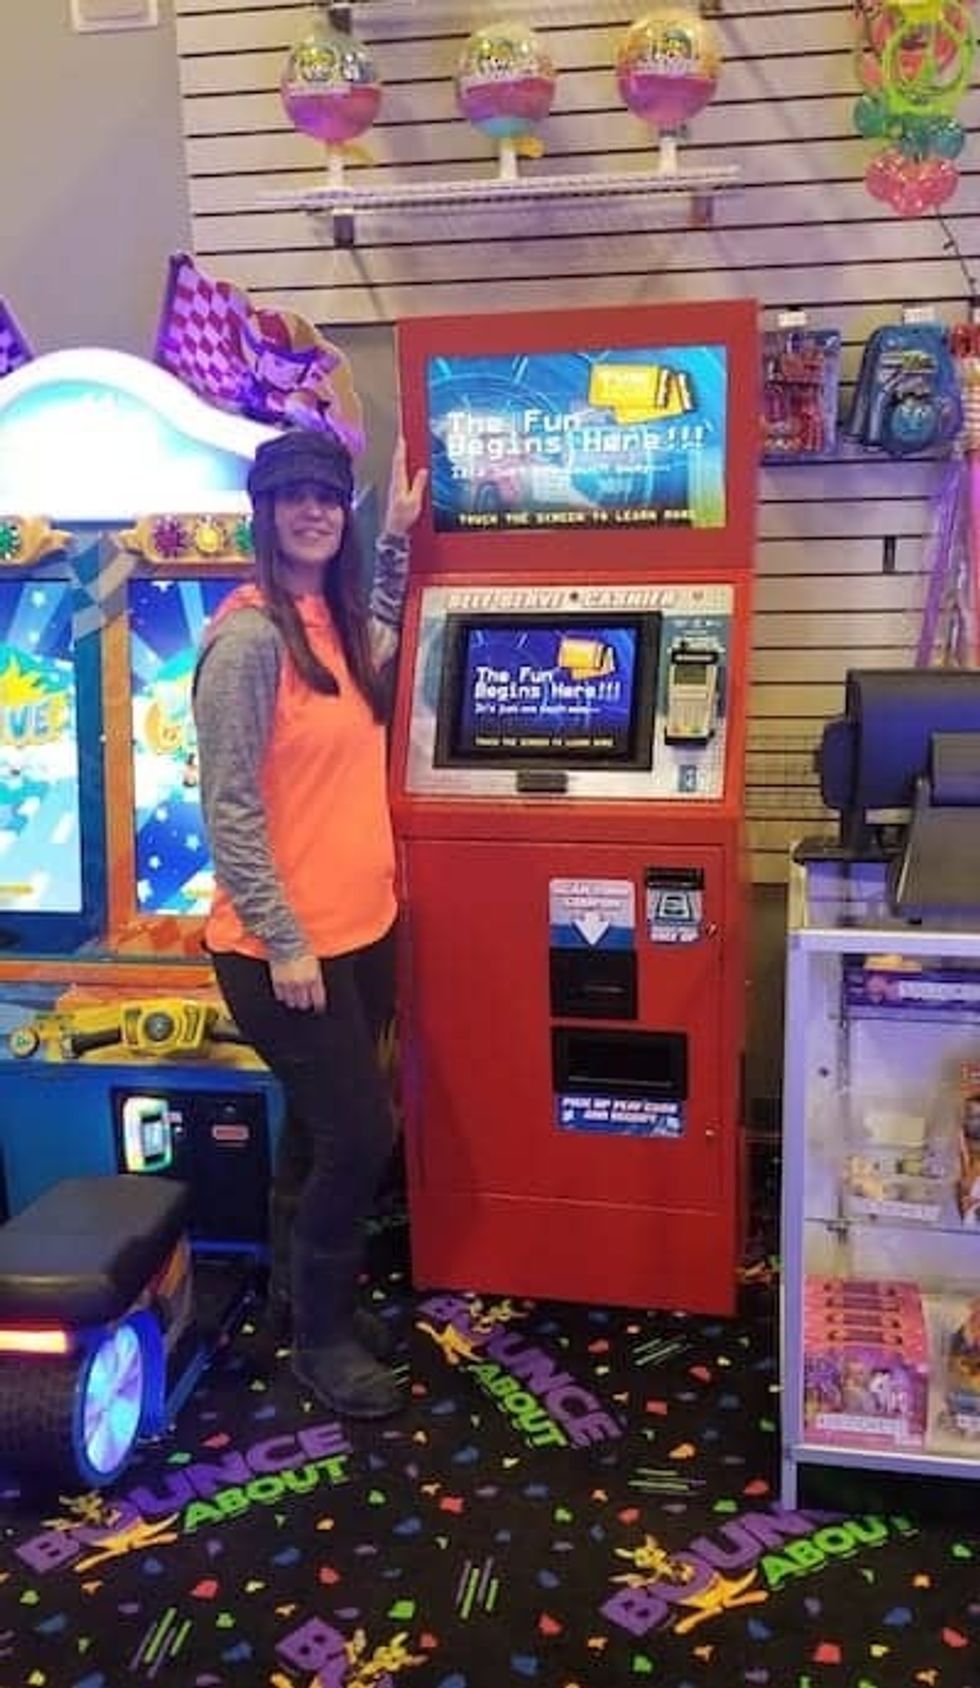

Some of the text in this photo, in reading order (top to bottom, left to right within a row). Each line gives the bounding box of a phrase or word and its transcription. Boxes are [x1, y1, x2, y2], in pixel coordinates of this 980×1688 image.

[523, 408, 580, 433] Fun
[474, 681, 541, 702] Begins
[475, 666, 553, 683] The Fun
[416, 1296, 624, 1449] BOUNCE
[467, 1363, 568, 1447] ABOUT
[14, 1421, 354, 1574] BOUNCE
[183, 1455, 350, 1534] ABOUT
